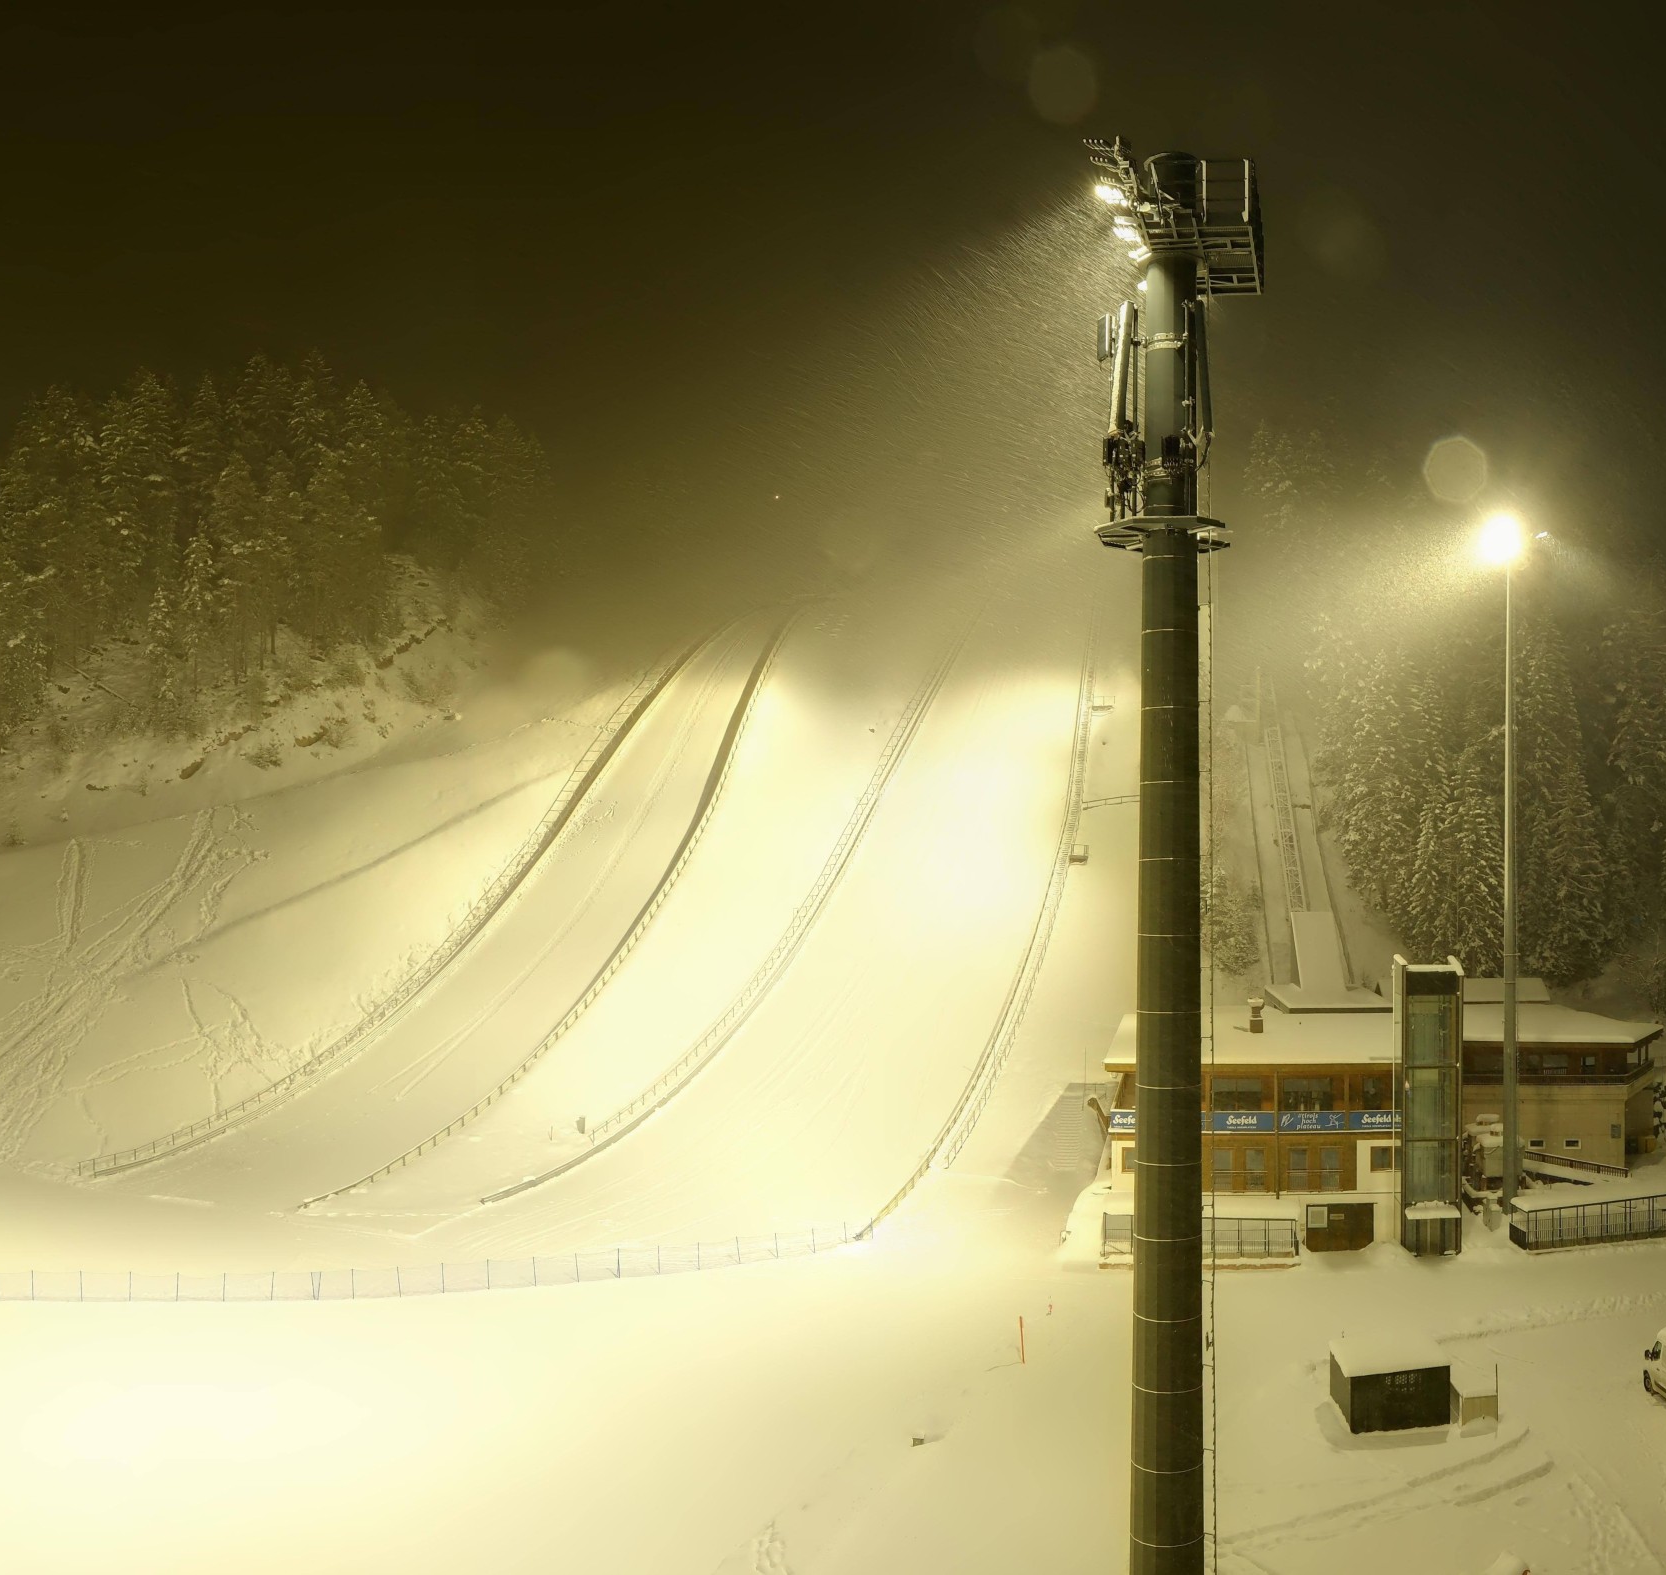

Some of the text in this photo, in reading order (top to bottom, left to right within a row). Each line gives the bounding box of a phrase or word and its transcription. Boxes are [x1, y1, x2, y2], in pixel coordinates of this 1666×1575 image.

[1113, 1115, 1135, 1125] Seefe
[1226, 1115, 1257, 1125] Seefeld
[1361, 1114, 1391, 1124] Seefeld
[1296, 1122, 1321, 1130] plateau
